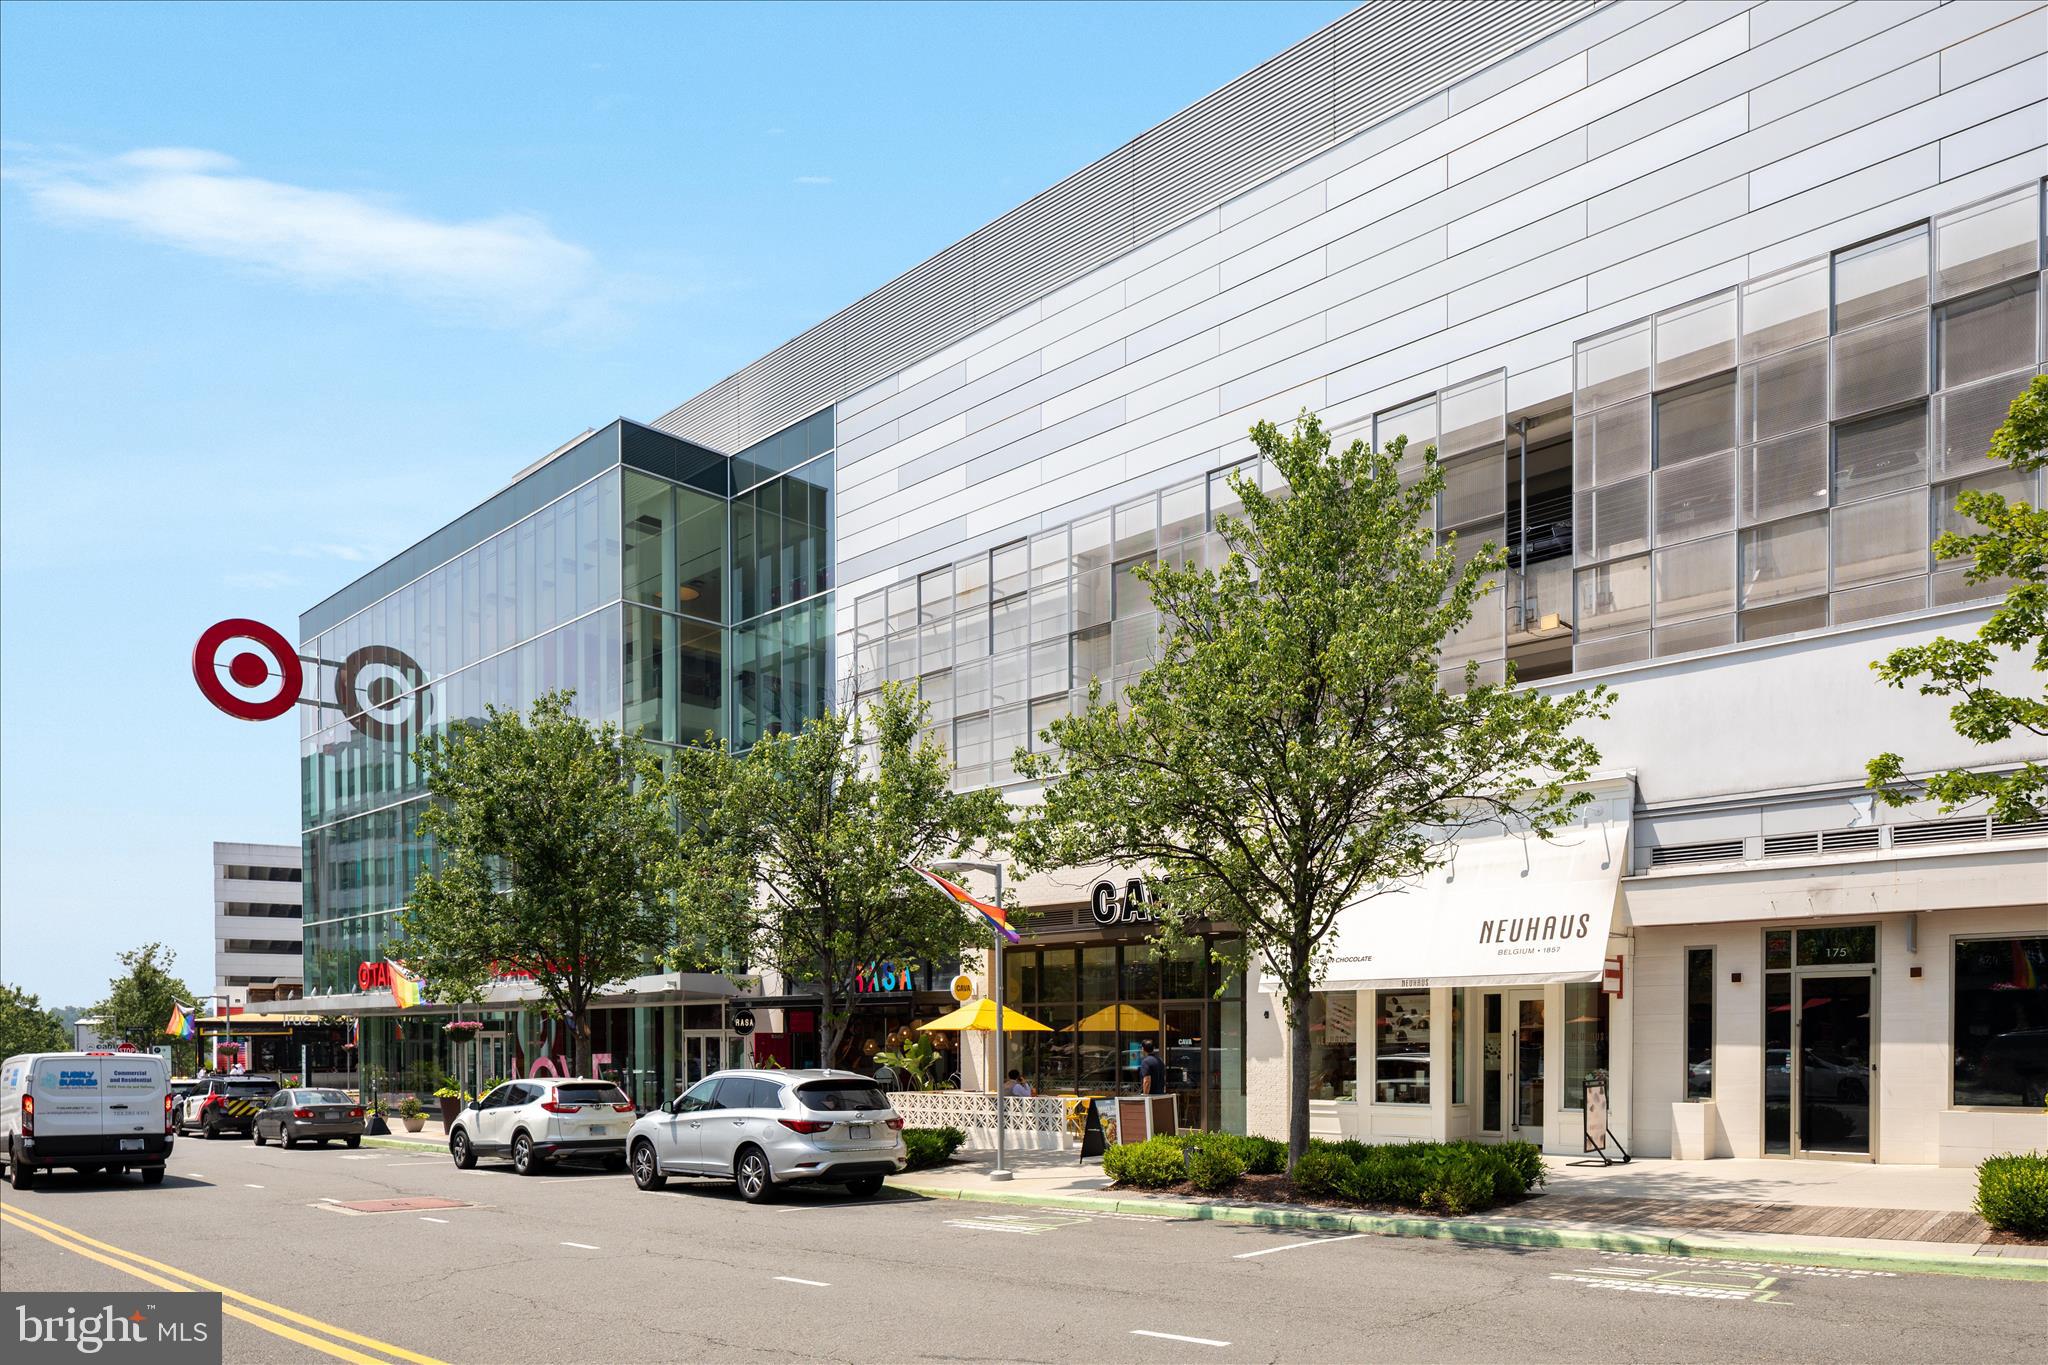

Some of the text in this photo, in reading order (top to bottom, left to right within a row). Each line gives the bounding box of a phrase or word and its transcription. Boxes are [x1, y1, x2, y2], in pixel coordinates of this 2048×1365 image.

[1479, 913, 1591, 944] NEUHAUS
[1497, 946, 1561, 956] BELGIUM 1857
[1826, 947, 1848, 958] 175
[1336, 955, 1373, 963] CHOCOLATE
[1401, 979, 1430, 988] NEUHAUS
[735, 1018, 754, 1027] RASA
